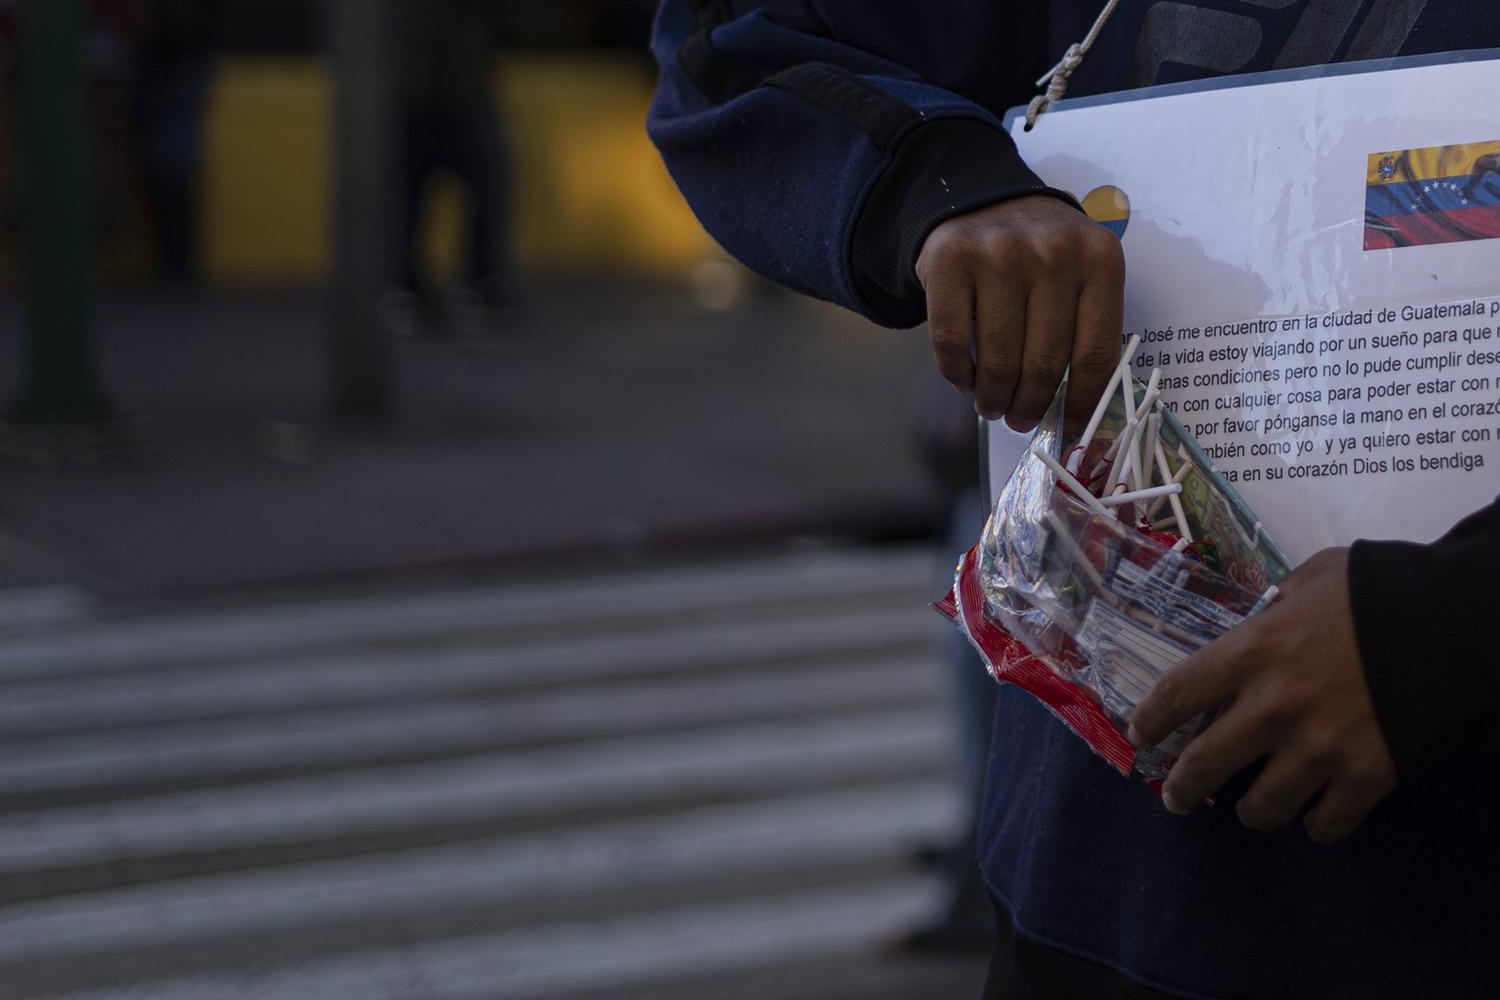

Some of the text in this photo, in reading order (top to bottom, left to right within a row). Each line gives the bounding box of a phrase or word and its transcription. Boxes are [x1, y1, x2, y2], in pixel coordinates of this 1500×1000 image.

[1140, 326, 1174, 344] José
[1178, 327, 1200, 341] me
[1204, 319, 1278, 338] encuentro
[1282, 317, 1300, 331] en
[1305, 313, 1318, 329] la
[1322, 309, 1373, 328] ciudad
[1377, 308, 1397, 324] de
[1401, 300, 1486, 322] Guatemala
[1136, 352, 1154, 368] de
[1158, 350, 1171, 366] la
[1175, 348, 1205, 365] vida
[1209, 346, 1249, 363] estoy
[1252, 339, 1315, 361] viajando
[1319, 337, 1344, 356] por
[1348, 337, 1367, 351] un
[1371, 330, 1419, 349] sueño
[1423, 329, 1458, 348] para
[1462, 326, 1492, 344] que
[1193, 367, 1280, 388] condiciones
[1284, 363, 1318, 383] pero
[1322, 363, 1341, 378] no
[1346, 359, 1359, 376] lo
[1363, 357, 1402, 378] pude
[1406, 350, 1463, 372] cumplir
[1183, 399, 1209, 412] con
[1215, 392, 1283, 410] cualquier
[1287, 389, 1321, 404] cosa
[1327, 386, 1361, 405] para
[1367, 381, 1411, 402] poder
[1416, 378, 1457, 395] estar
[1461, 376, 1490, 392] con
[1195, 422, 1219, 439] por
[1223, 416, 1260, 434] favor
[1264, 411, 1338, 434] pónganse
[1343, 409, 1356, 425] la
[1360, 408, 1404, 424] mano
[1408, 406, 1427, 420] en
[1432, 402, 1446, 418] el
[1251, 441, 1291, 456] como
[1296, 439, 1314, 457] yo
[1325, 438, 1334, 455] y
[1338, 437, 1357, 454] ya
[1362, 431, 1411, 453] quiero
[1416, 428, 1457, 445] estar
[1461, 426, 1491, 443] con
[1242, 468, 1261, 483] en
[1266, 465, 1284, 481] su
[1287, 460, 1348, 478] corazón
[1353, 456, 1388, 475] Dios
[1392, 455, 1415, 472] los
[1420, 452, 1484, 472] bendiga
